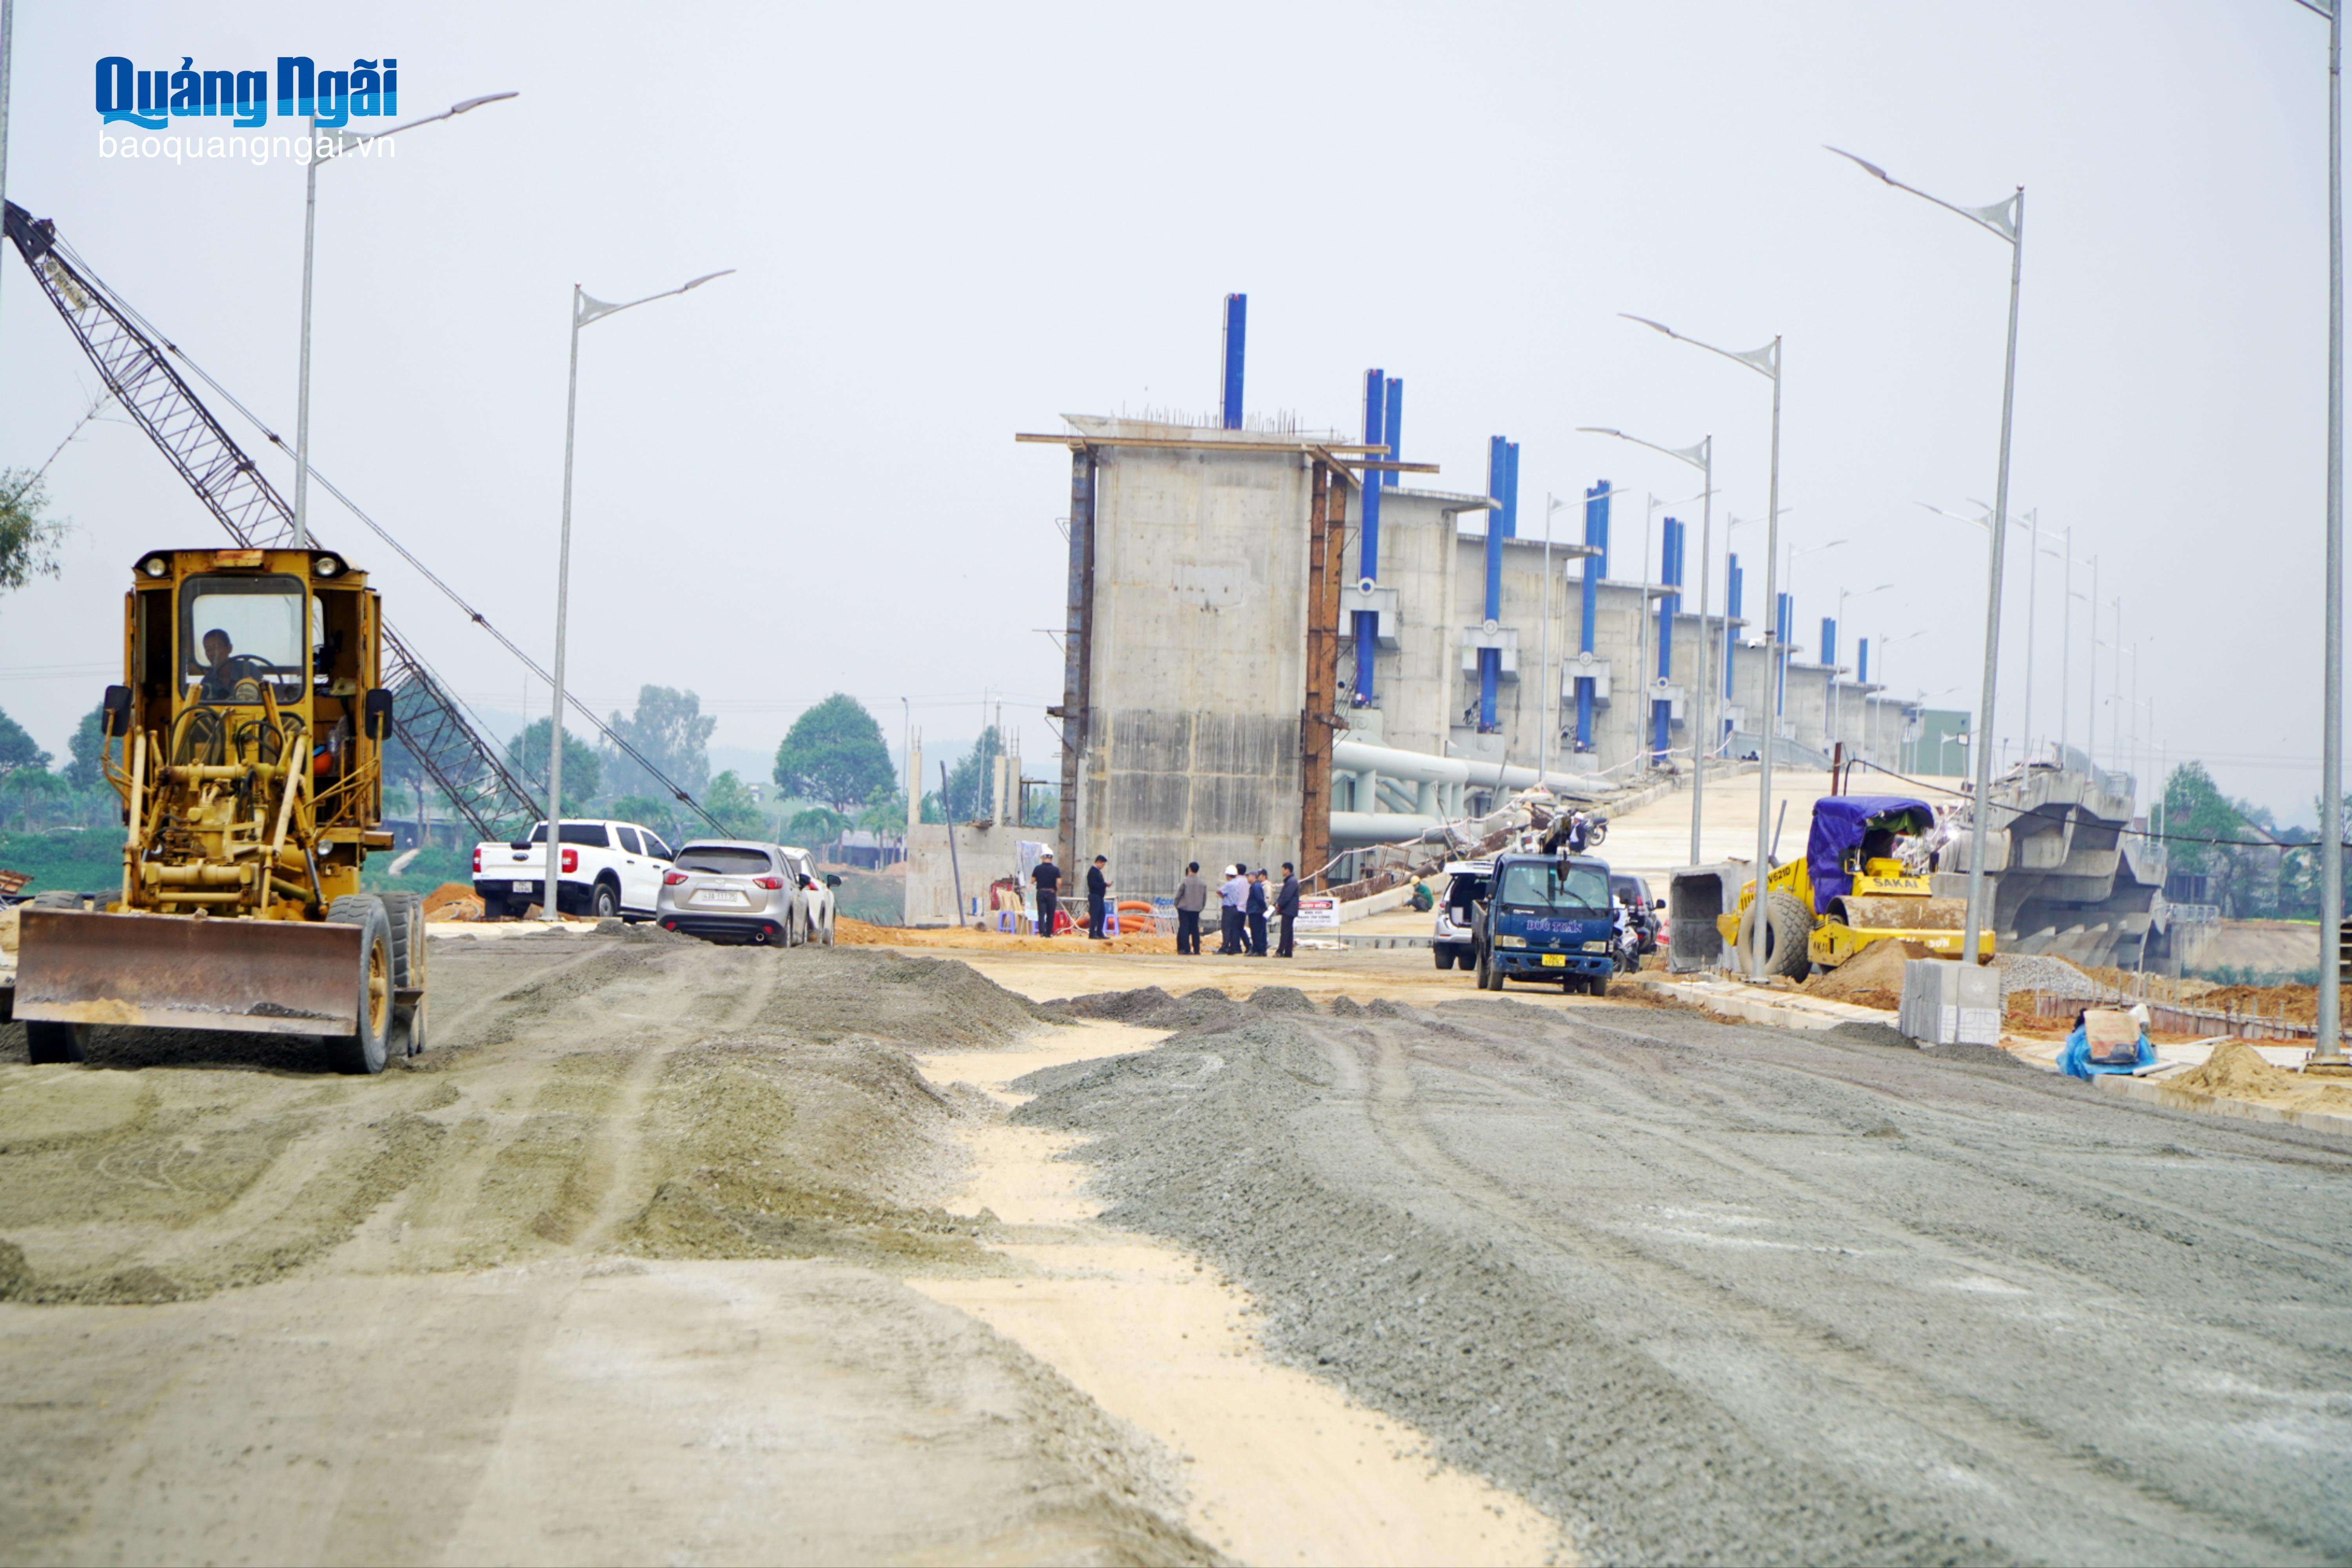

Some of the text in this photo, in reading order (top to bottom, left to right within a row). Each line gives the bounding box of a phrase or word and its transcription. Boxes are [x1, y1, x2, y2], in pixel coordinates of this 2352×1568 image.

[1873, 878, 1918, 888] SAKAI
[1527, 918, 1583, 933] ĐỨC TUẤN
